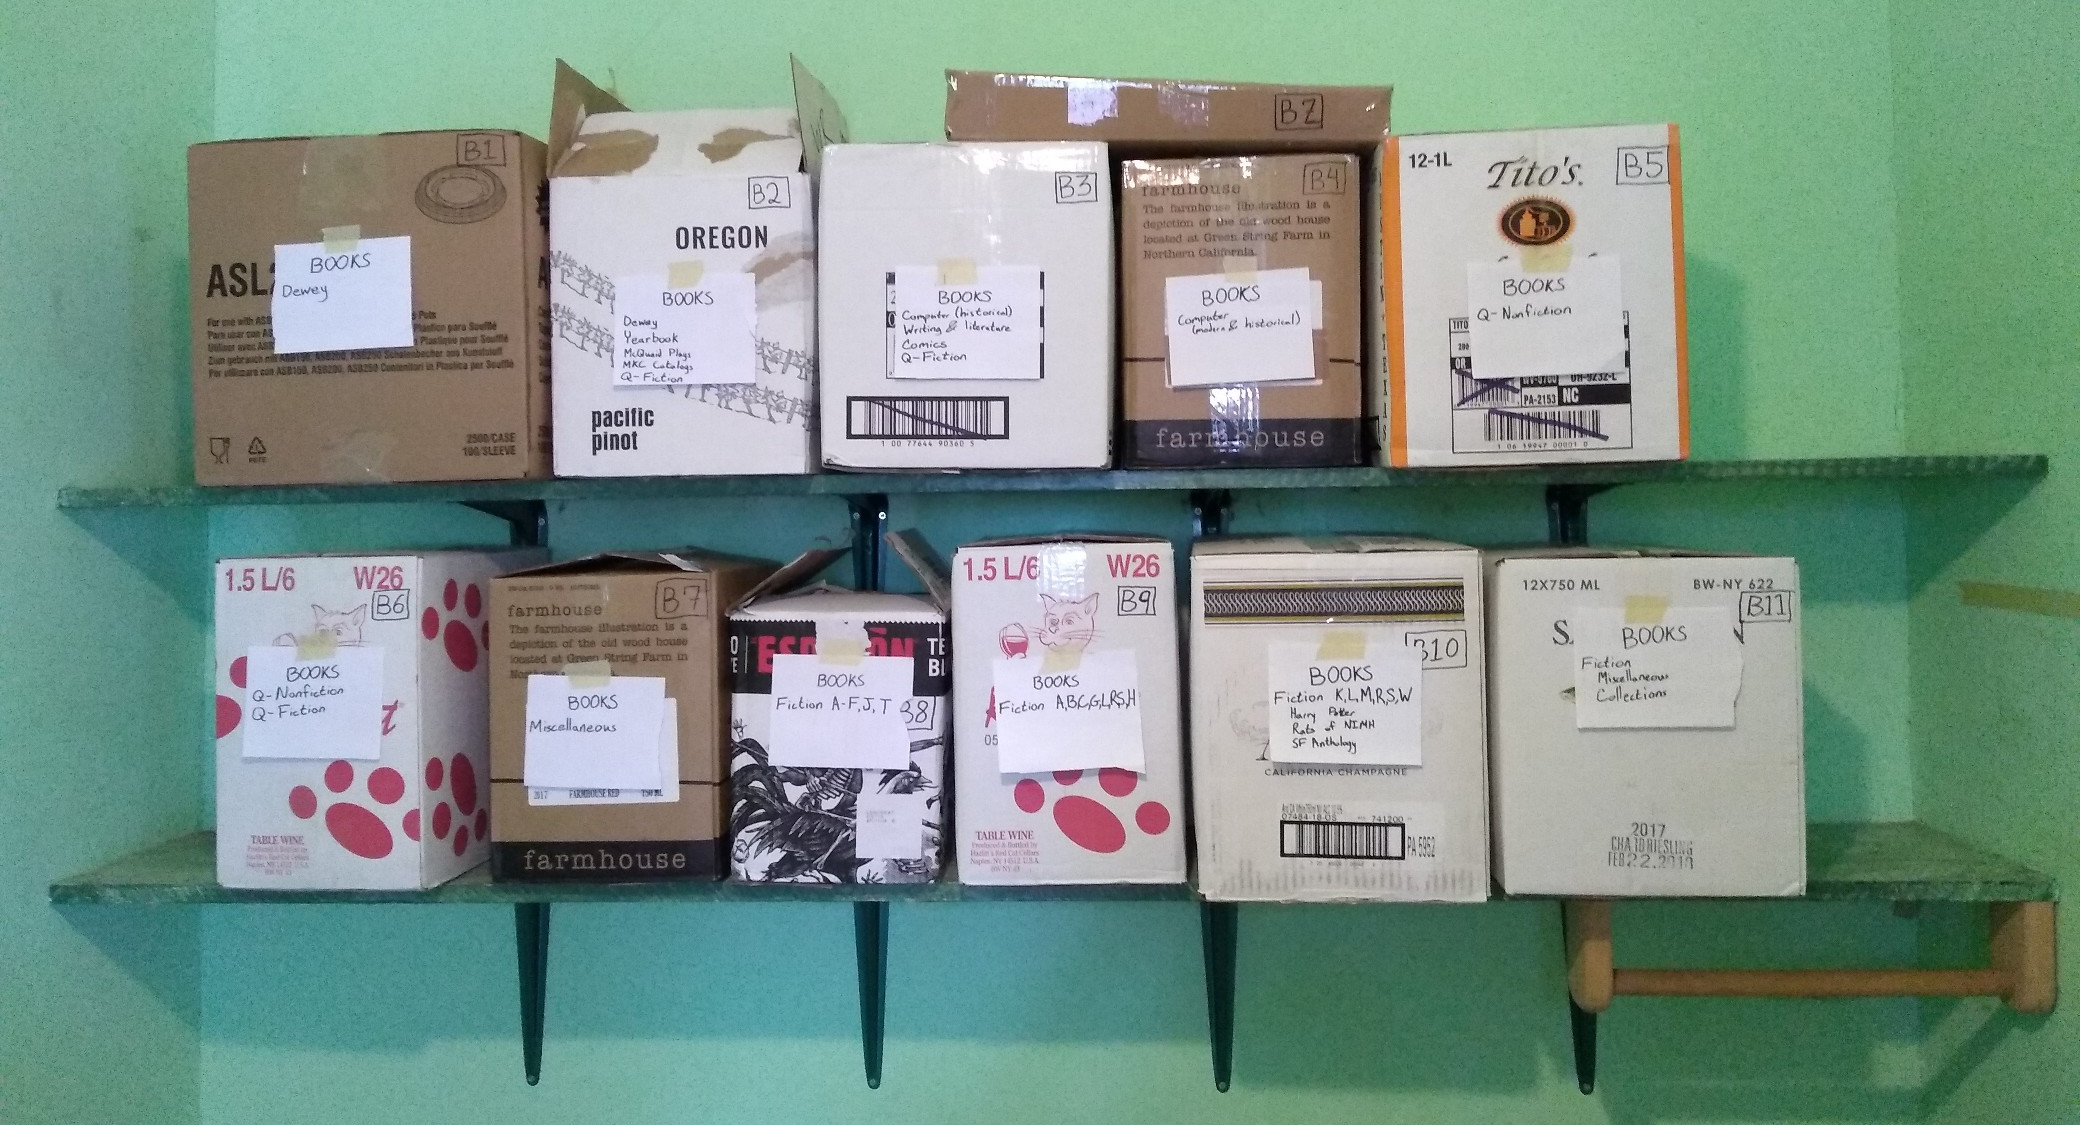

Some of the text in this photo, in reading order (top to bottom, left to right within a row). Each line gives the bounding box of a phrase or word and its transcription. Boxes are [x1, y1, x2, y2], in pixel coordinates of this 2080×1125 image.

[464, 141, 496, 161] B1
[1409, 152, 1452, 168] 12-1L
[1625, 151, 1664, 178] B5
[1058, 175, 1092, 199] B3
[1311, 169, 1339, 191] B4
[753, 182, 781, 205] B2
[1143, 204, 1164, 214] The
[1296, 215, 1331, 225] house
[675, 225, 769, 250] OREGON
[1283, 230, 1314, 240] Farm
[1143, 249, 1195, 260] Northern
[310, 253, 371, 274] BOOKS
[206, 263, 276, 298] ASL
[1503, 278, 1565, 296] BOOKS
[282, 284, 328, 302] Dewey
[662, 291, 714, 307] BOOKS
[938, 290, 992, 305] BOOKS
[1202, 285, 1260, 307] BOOKS
[623, 316, 658, 330] Dewey
[901, 310, 949, 323] Computer
[1178, 311, 1229, 326] Computer
[903, 324, 943, 336] Writing
[964, 320, 1011, 332] literature
[623, 330, 679, 345] Yearbook
[901, 339, 948, 350] Comics
[668, 348, 692, 360] Plays
[1524, 394, 1556, 406] PA-2153
[1562, 388, 1579, 404] NC
[591, 407, 655, 433] pacific
[591, 431, 638, 456] pinot
[963, 555, 1040, 581] 1.5 L/6
[1107, 554, 1160, 578] W26
[226, 567, 296, 591] 1.5 L/6
[353, 566, 404, 589] W26
[1523, 579, 1601, 591] 12X750 ML
[1693, 578, 1774, 590] BW-NY 622
[376, 595, 405, 615] B6
[663, 586, 701, 613] B7
[1121, 589, 1151, 612] B9
[1748, 595, 1786, 616] B11
[508, 604, 603, 617] farmhouse
[509, 625, 529, 634] The
[534, 624, 593, 633] farmhouse
[599, 622, 659, 632] illustration
[509, 638, 558, 650] depiction
[562, 638, 573, 648] of
[577, 638, 596, 648] the
[623, 637, 650, 647] wood
[656, 637, 688, 647] house
[1622, 625, 1688, 649] BOOKS
[642, 652, 671, 662] Farm
[677, 652, 688, 662] in
[1581, 656, 1632, 670] Fiction
[286, 665, 340, 682] BOOKS
[817, 674, 865, 687] BOOKS
[1309, 666, 1373, 686] BOOKS
[1033, 675, 1080, 689] BOOKS
[568, 695, 618, 710] BOOKS
[1274, 691, 1323, 705] Fiction
[1597, 688, 1667, 702] Collections
[776, 697, 823, 710] Fiction
[999, 700, 1045, 714] Fiction
[1290, 707, 1355, 722] Harry Potter
[529, 717, 617, 733] Miscellaneous
[1292, 738, 1306, 749] SF
[1265, 768, 1408, 776] CALIFORNIA CHAMPAGNE
[975, 830, 1034, 840] TABLE WINE
[1631, 822, 1666, 838] 2017
[251, 835, 305, 845] TABLE WINE
[524, 850, 686, 870] farmhouse
